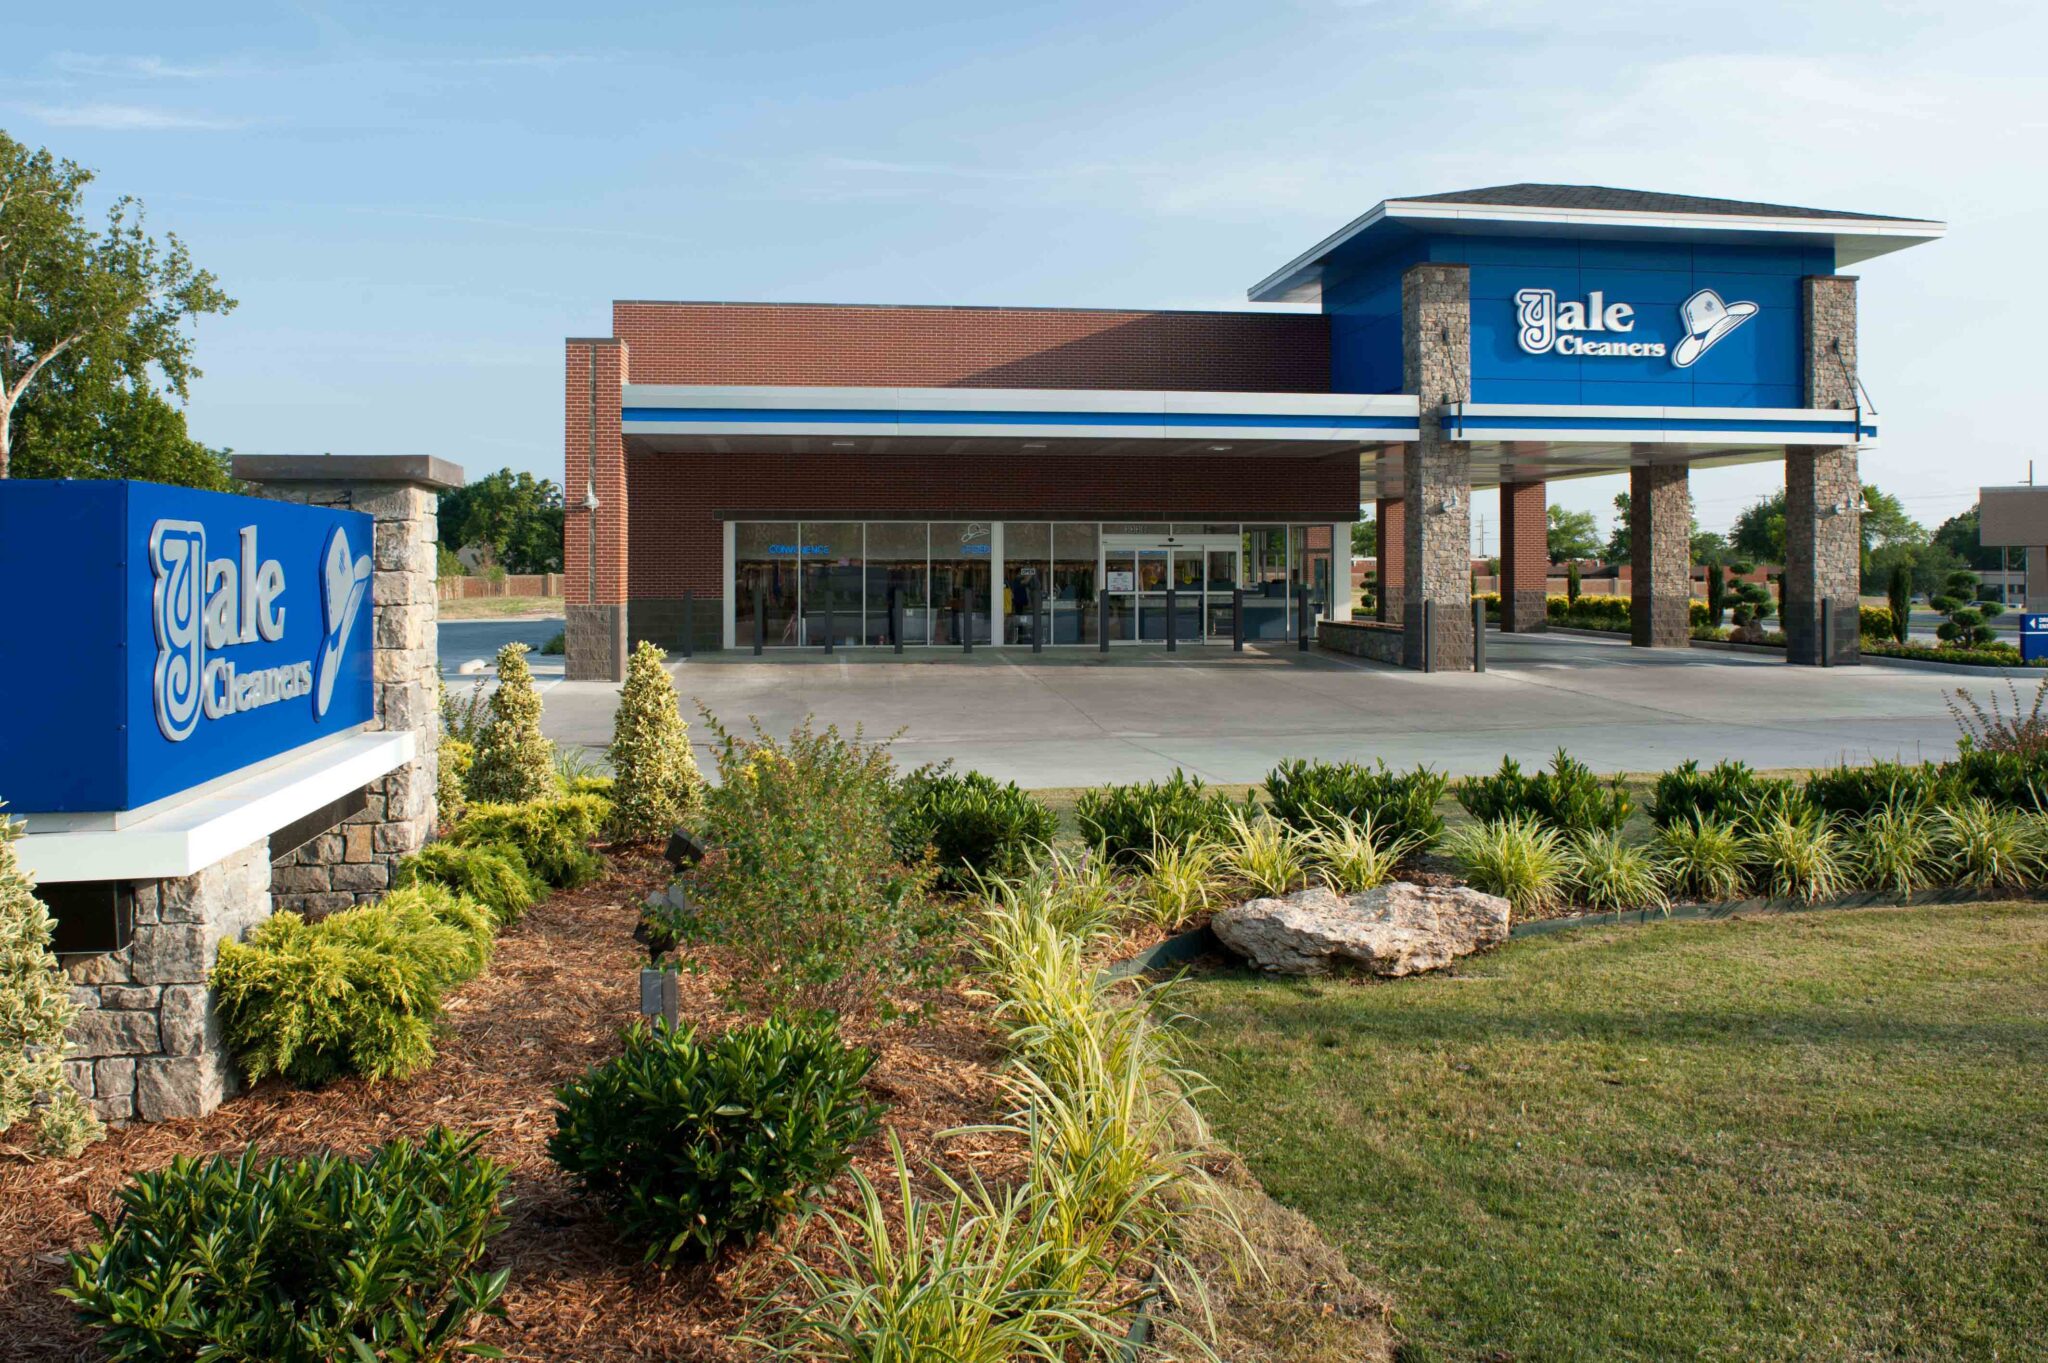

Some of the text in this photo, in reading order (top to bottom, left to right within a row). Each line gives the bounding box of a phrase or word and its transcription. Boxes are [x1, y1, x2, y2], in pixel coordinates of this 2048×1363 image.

[1514, 288, 1635, 355] Yale
[1555, 334, 1667, 358] Cleaners
[148, 518, 287, 742] Yale
[203, 657, 313, 720] Cleaners
